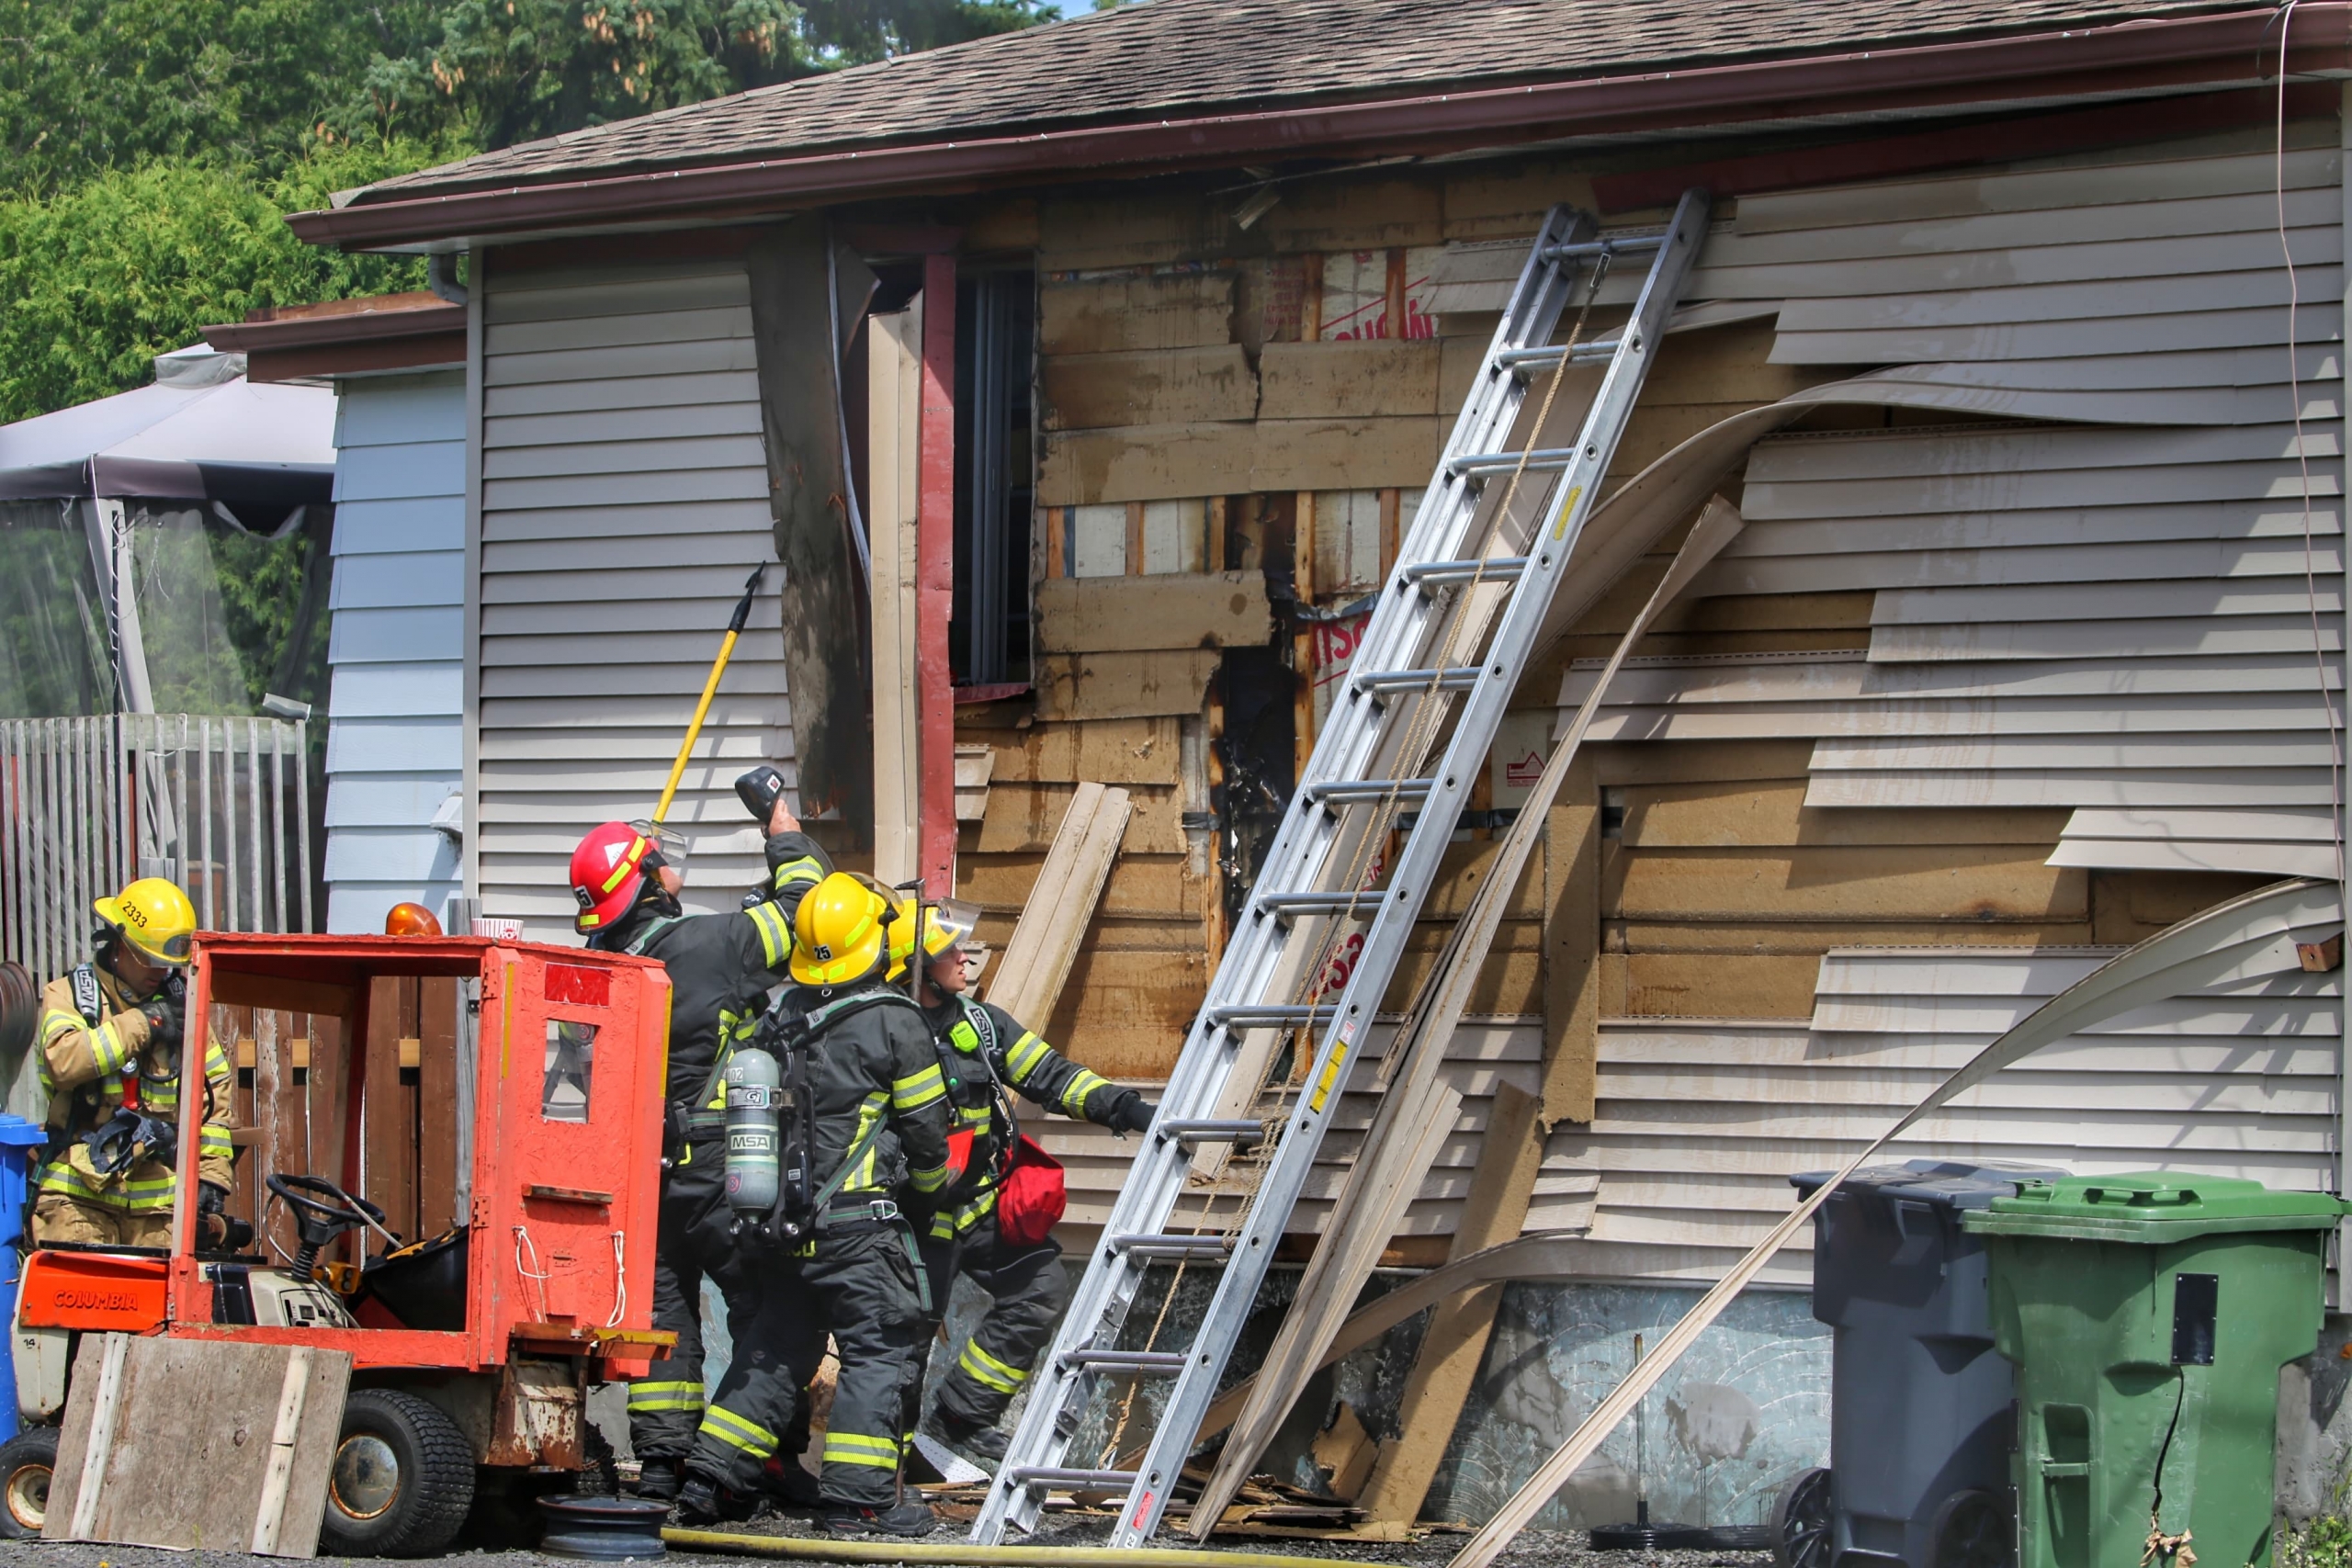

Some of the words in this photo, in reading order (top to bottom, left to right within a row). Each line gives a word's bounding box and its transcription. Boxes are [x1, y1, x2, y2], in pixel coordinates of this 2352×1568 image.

[122, 900, 148, 928] 2333
[814, 945, 831, 960] 25
[79, 970, 94, 1001] MSA
[971, 1008, 992, 1046] MSA
[731, 1136, 769, 1147] MSA
[53, 1289, 138, 1311] COLUMBIA
[23, 1338, 36, 1347] 14
